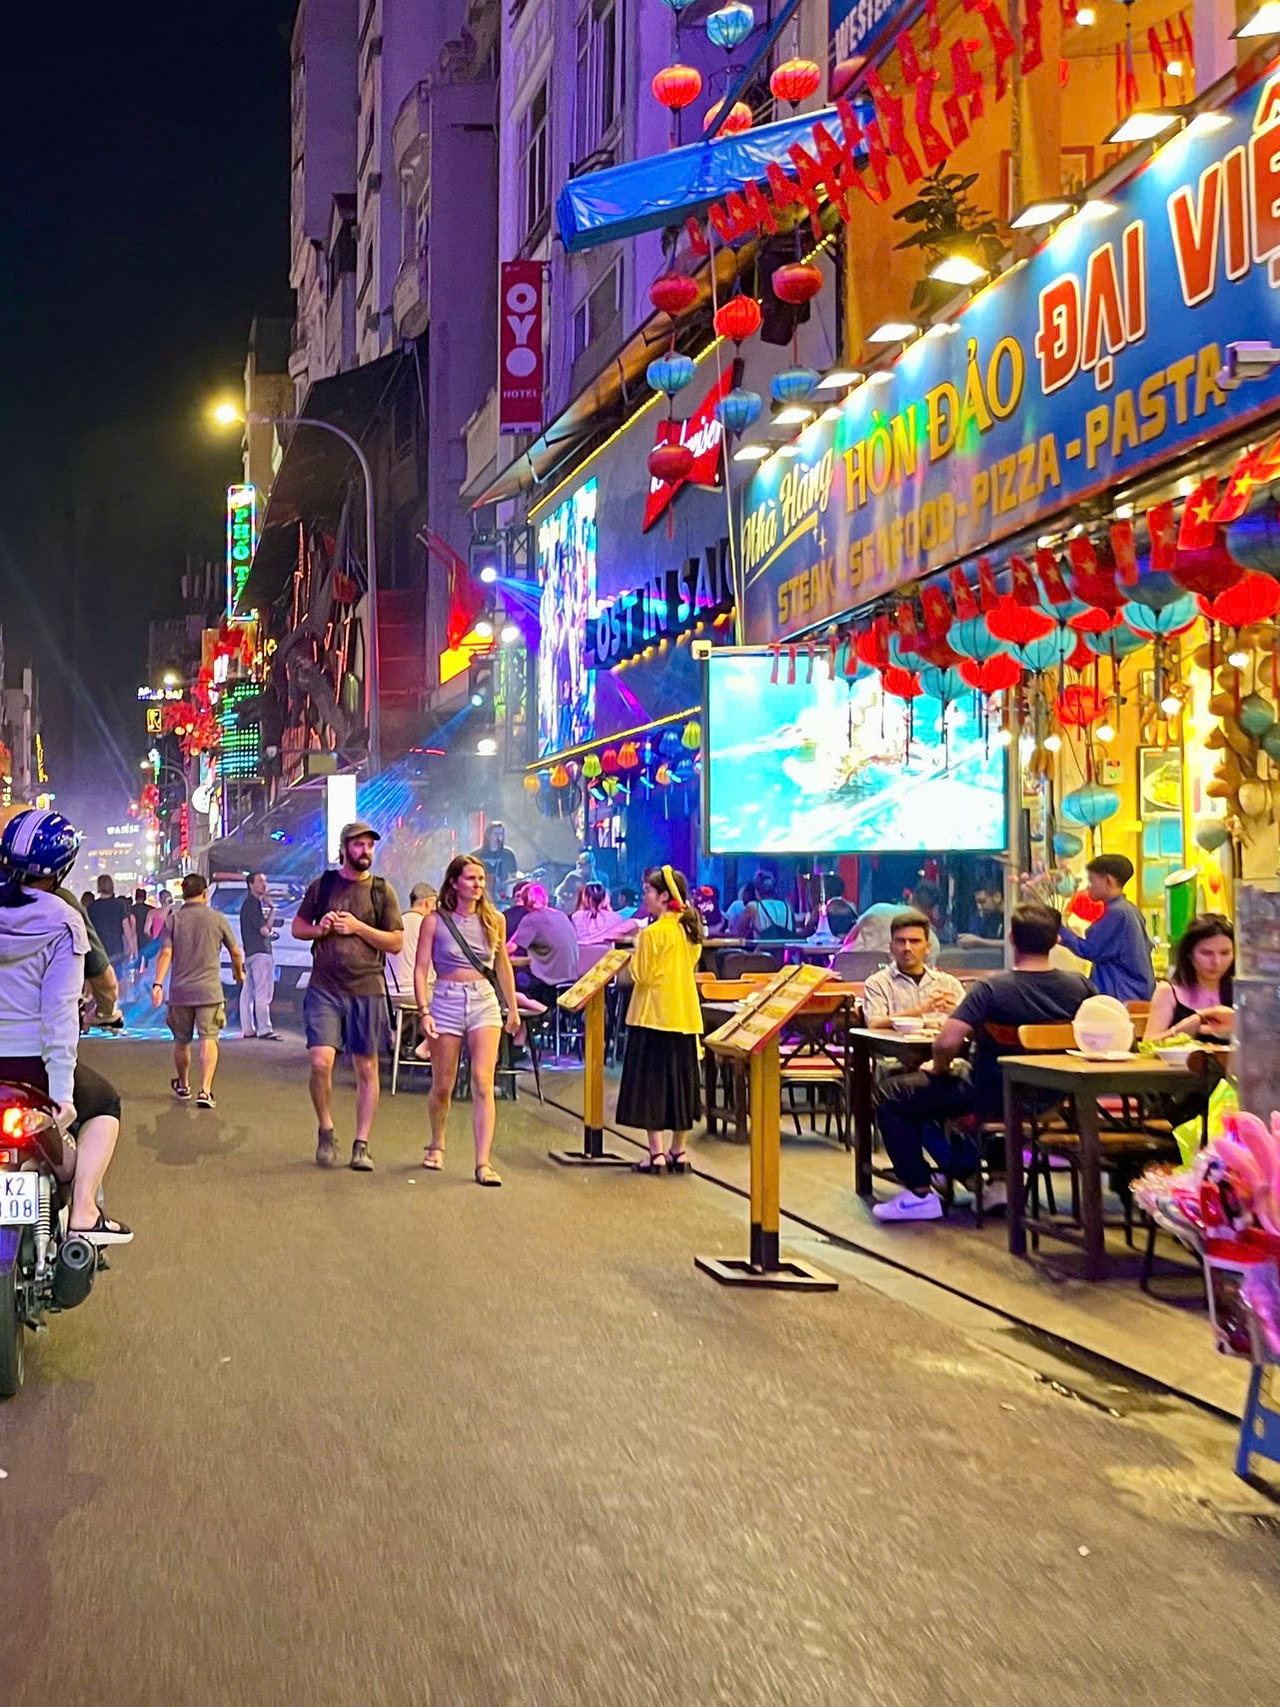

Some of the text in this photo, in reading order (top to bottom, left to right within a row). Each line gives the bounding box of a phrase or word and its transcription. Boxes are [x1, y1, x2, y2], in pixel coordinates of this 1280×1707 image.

[503, 388, 538, 399] HOTEL
[1035, 219, 1147, 395] ĐẠI
[777, 341, 1227, 625] STEAK SEAFOOD PIZZA PASTA
[779, 447, 834, 536] Hàng
[842, 336, 1024, 514] HÒN ĐẢO
